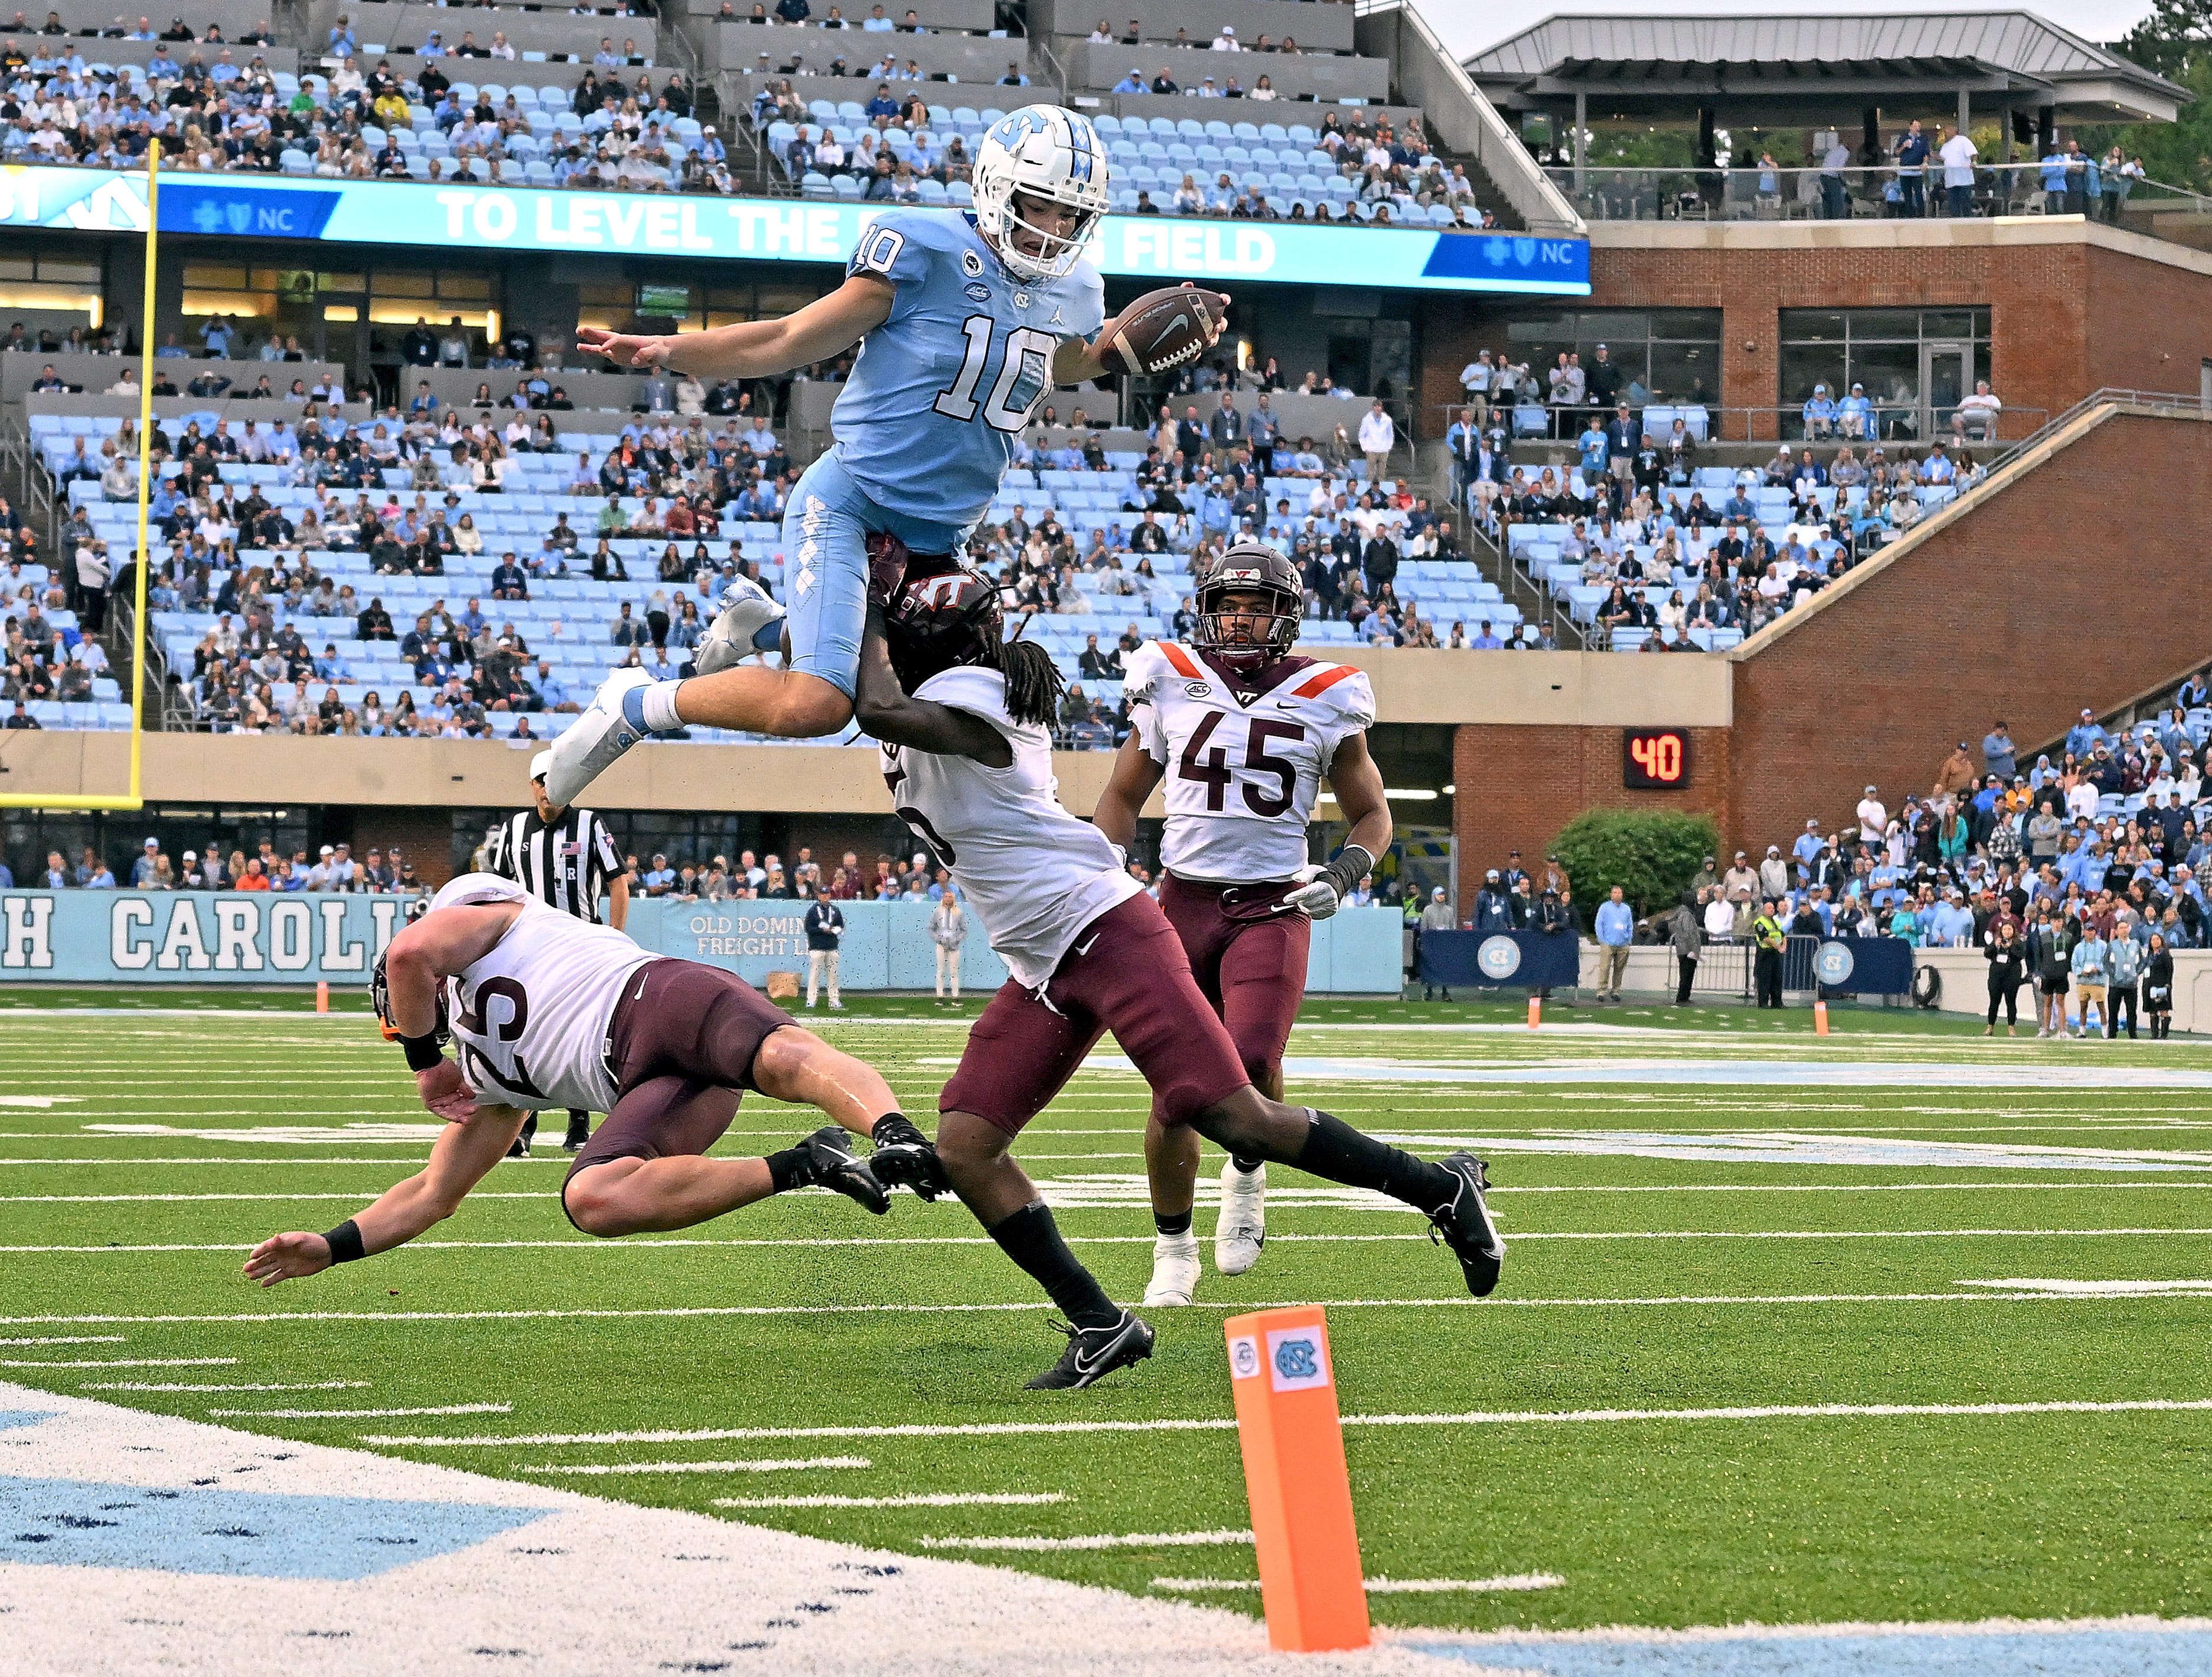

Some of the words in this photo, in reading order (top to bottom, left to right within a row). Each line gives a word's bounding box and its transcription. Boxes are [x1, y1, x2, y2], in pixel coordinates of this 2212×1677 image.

[257, 208, 293, 232] NC
[436, 193, 516, 240] TO
[537, 196, 713, 249] LEVEL
[729, 205, 839, 254] THE
[1124, 223, 1276, 273] FIELD
[855, 223, 905, 273] 10
[1541, 243, 1572, 264] NC
[966, 286, 989, 297] ACC
[932, 313, 1058, 434] 10
[1235, 570, 1251, 578] VT
[1236, 690, 1258, 703] VT
[1178, 710, 1305, 818] 45
[1631, 733, 1682, 782] 40
[567, 867, 576, 881] R
[110, 896, 415, 973] CAROLI
[690, 917, 732, 934] OLD
[697, 937, 787, 956] FREIGHT
